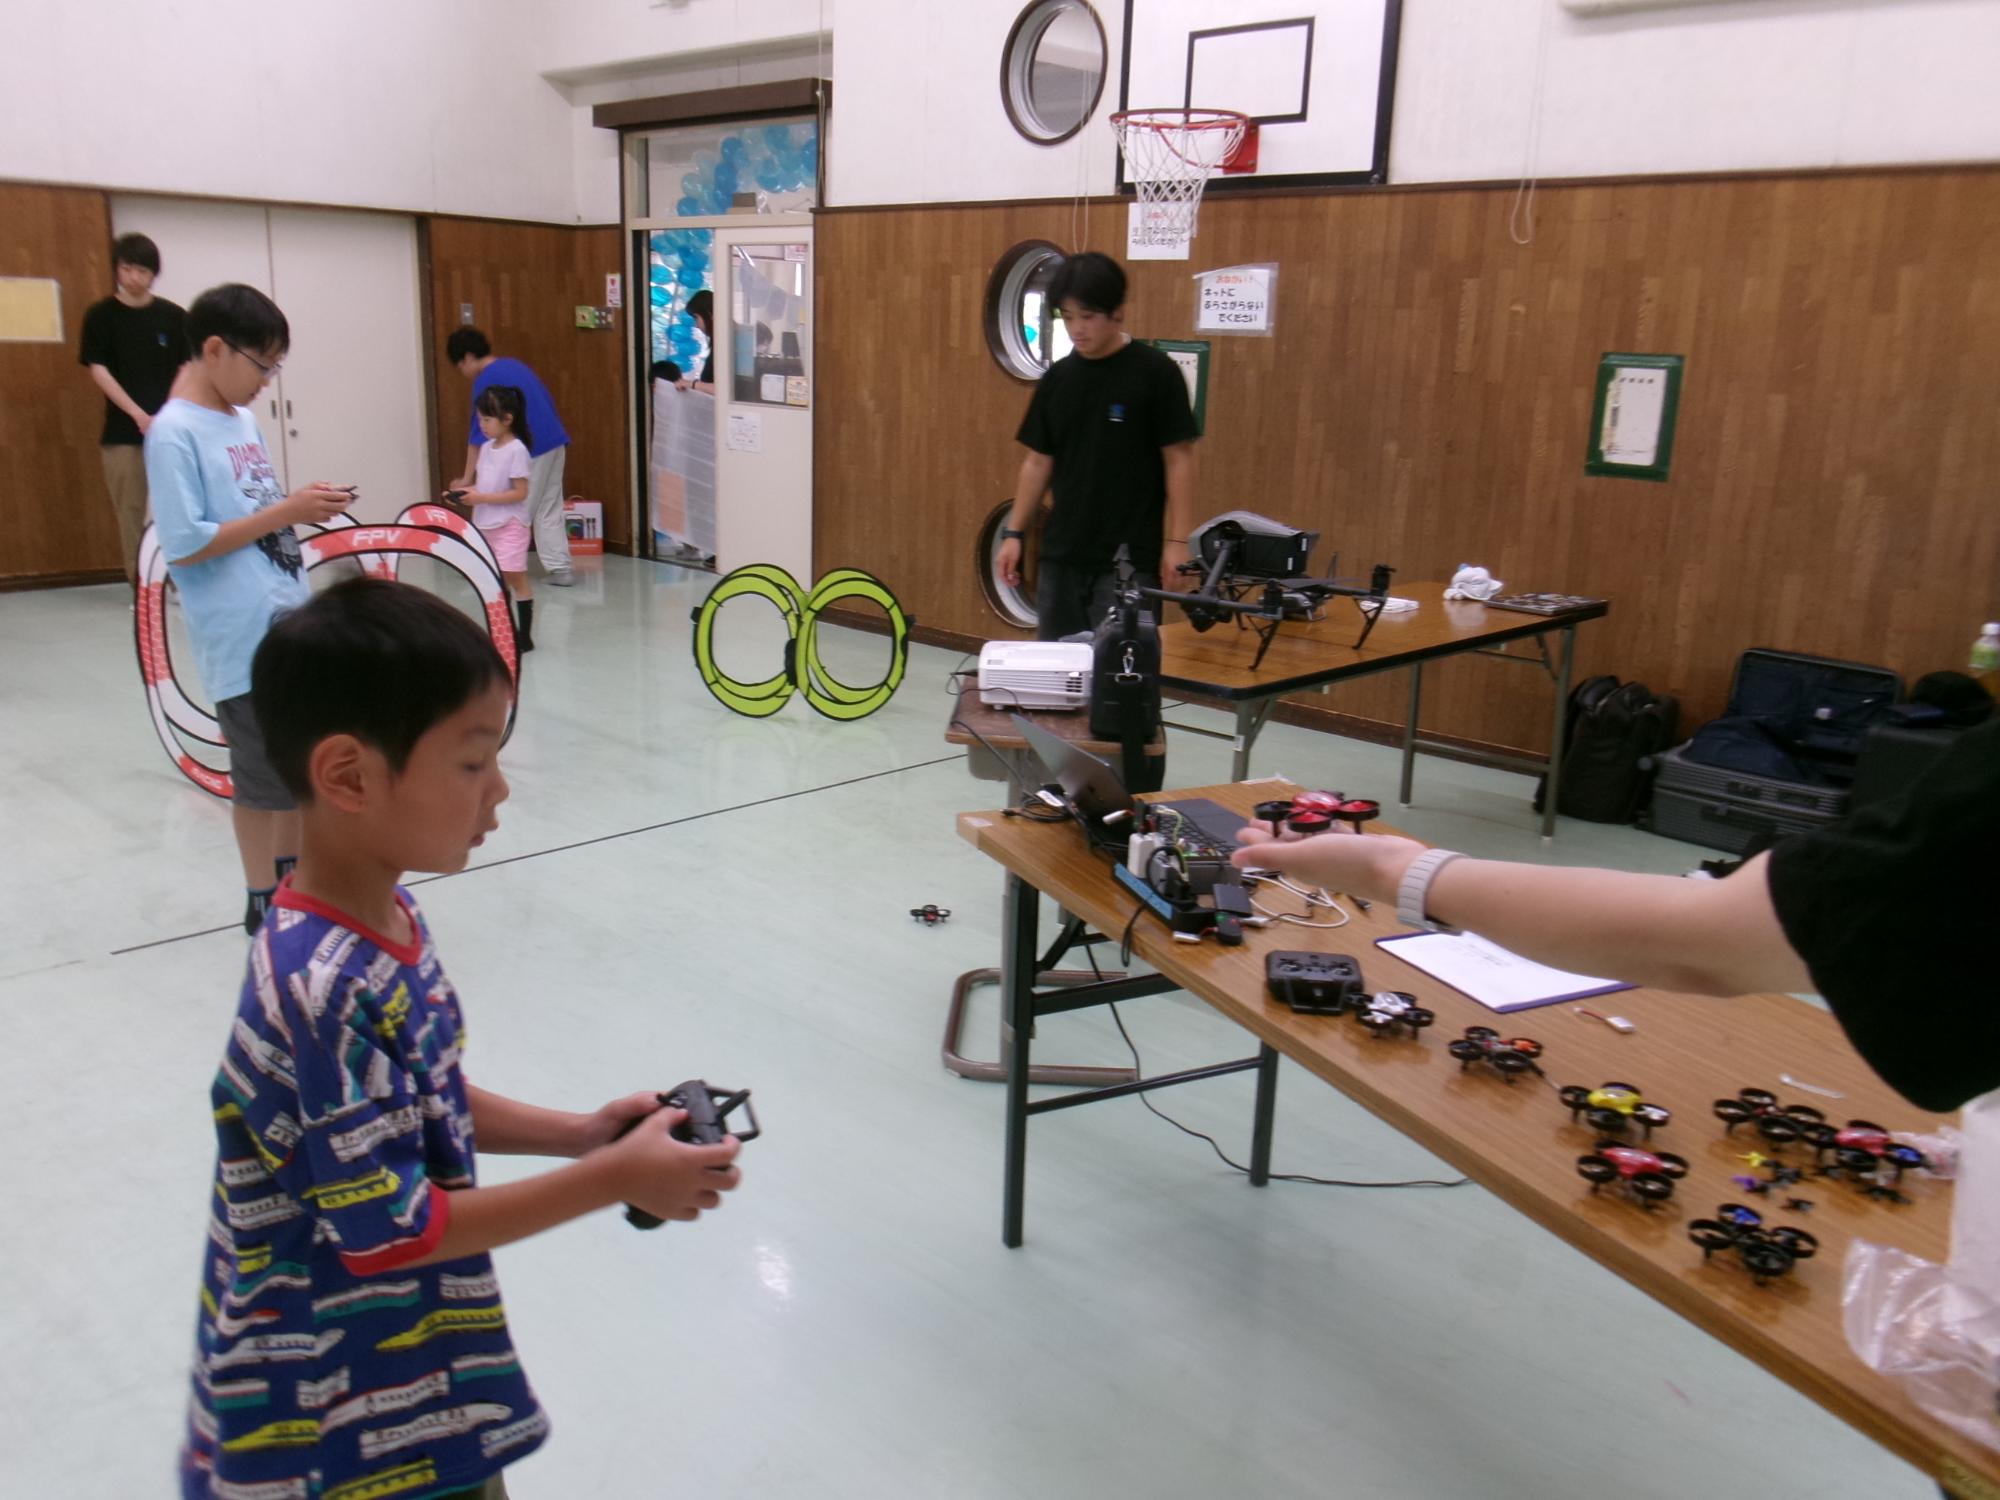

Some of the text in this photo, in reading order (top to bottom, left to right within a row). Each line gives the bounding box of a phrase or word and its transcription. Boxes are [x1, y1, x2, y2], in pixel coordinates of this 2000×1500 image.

[1204, 288, 1237, 297] ネットに
[1218, 313, 1258, 323] でください
[351, 529, 402, 547] FPV
